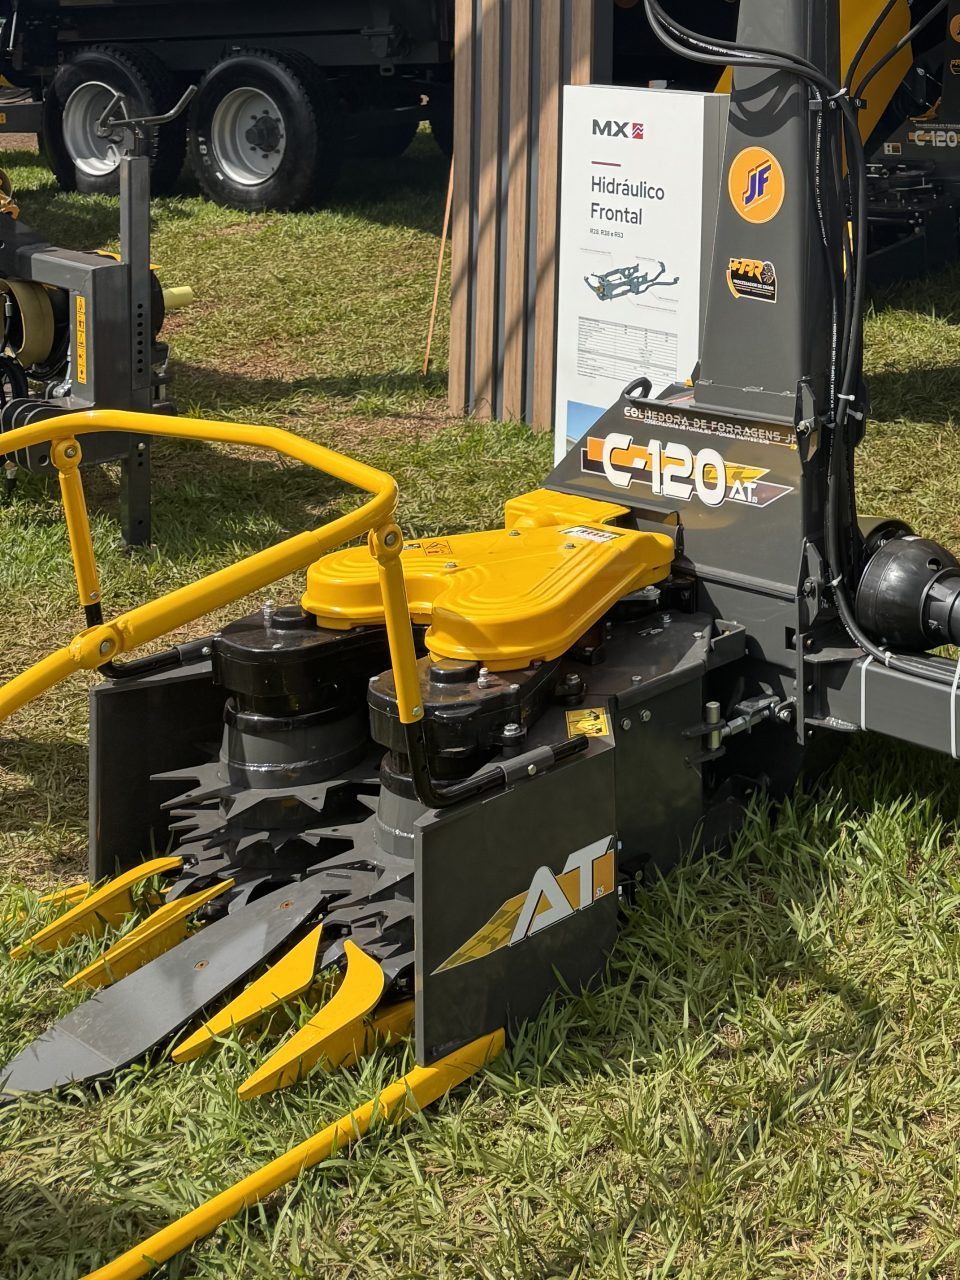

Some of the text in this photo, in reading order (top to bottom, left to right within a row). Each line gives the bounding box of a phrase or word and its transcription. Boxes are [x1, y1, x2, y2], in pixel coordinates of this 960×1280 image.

[592, 119, 630, 139] MX
[591, 175, 665, 200] Hidráulico
[742, 159, 772, 205] JF
[590, 202, 642, 225] Frontal
[623, 406, 688, 426] COLHEDORA
[693, 419, 707, 430] DE
[711, 421, 780, 442] FORRAGENS
[602, 432, 757, 507] C-120 AT
[508, 834, 614, 947] AT
